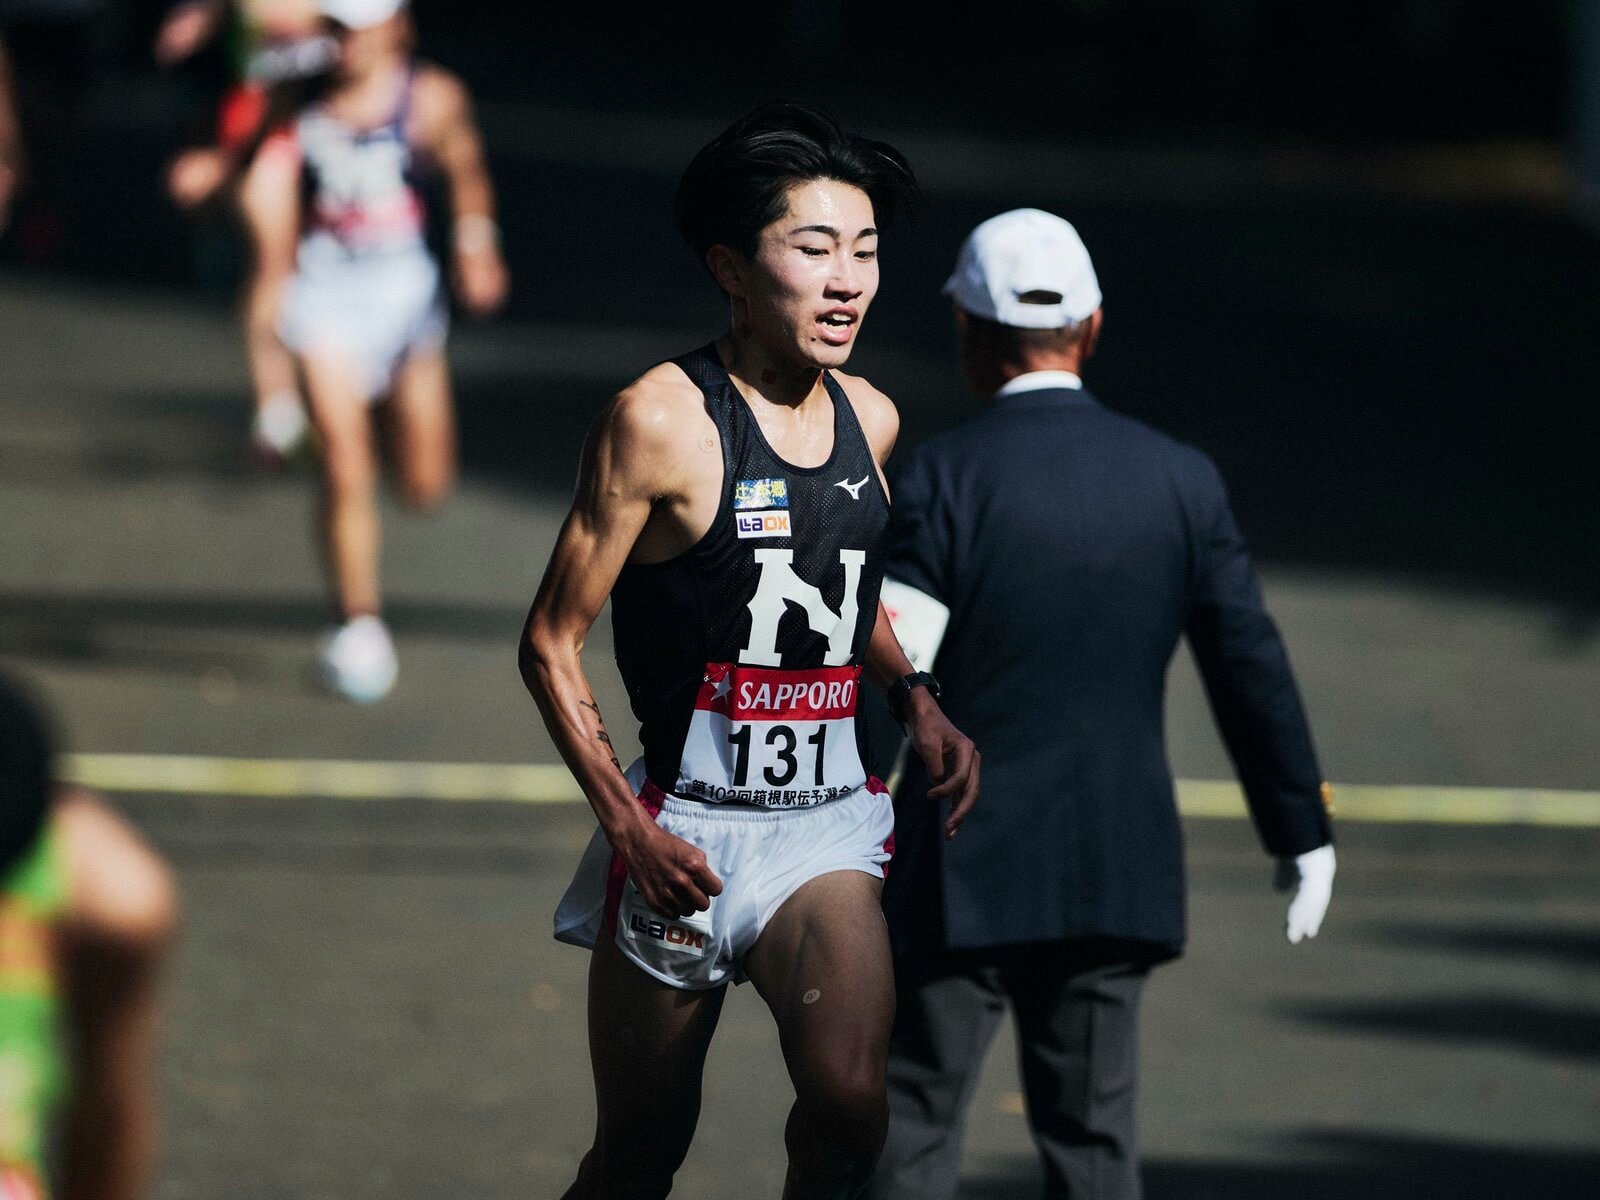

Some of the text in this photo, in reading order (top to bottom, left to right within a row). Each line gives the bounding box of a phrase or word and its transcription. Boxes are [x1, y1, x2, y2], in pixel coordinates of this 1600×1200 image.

[738, 548, 866, 667] N
[737, 680, 854, 710] SAPPORO
[728, 723, 828, 787] 131
